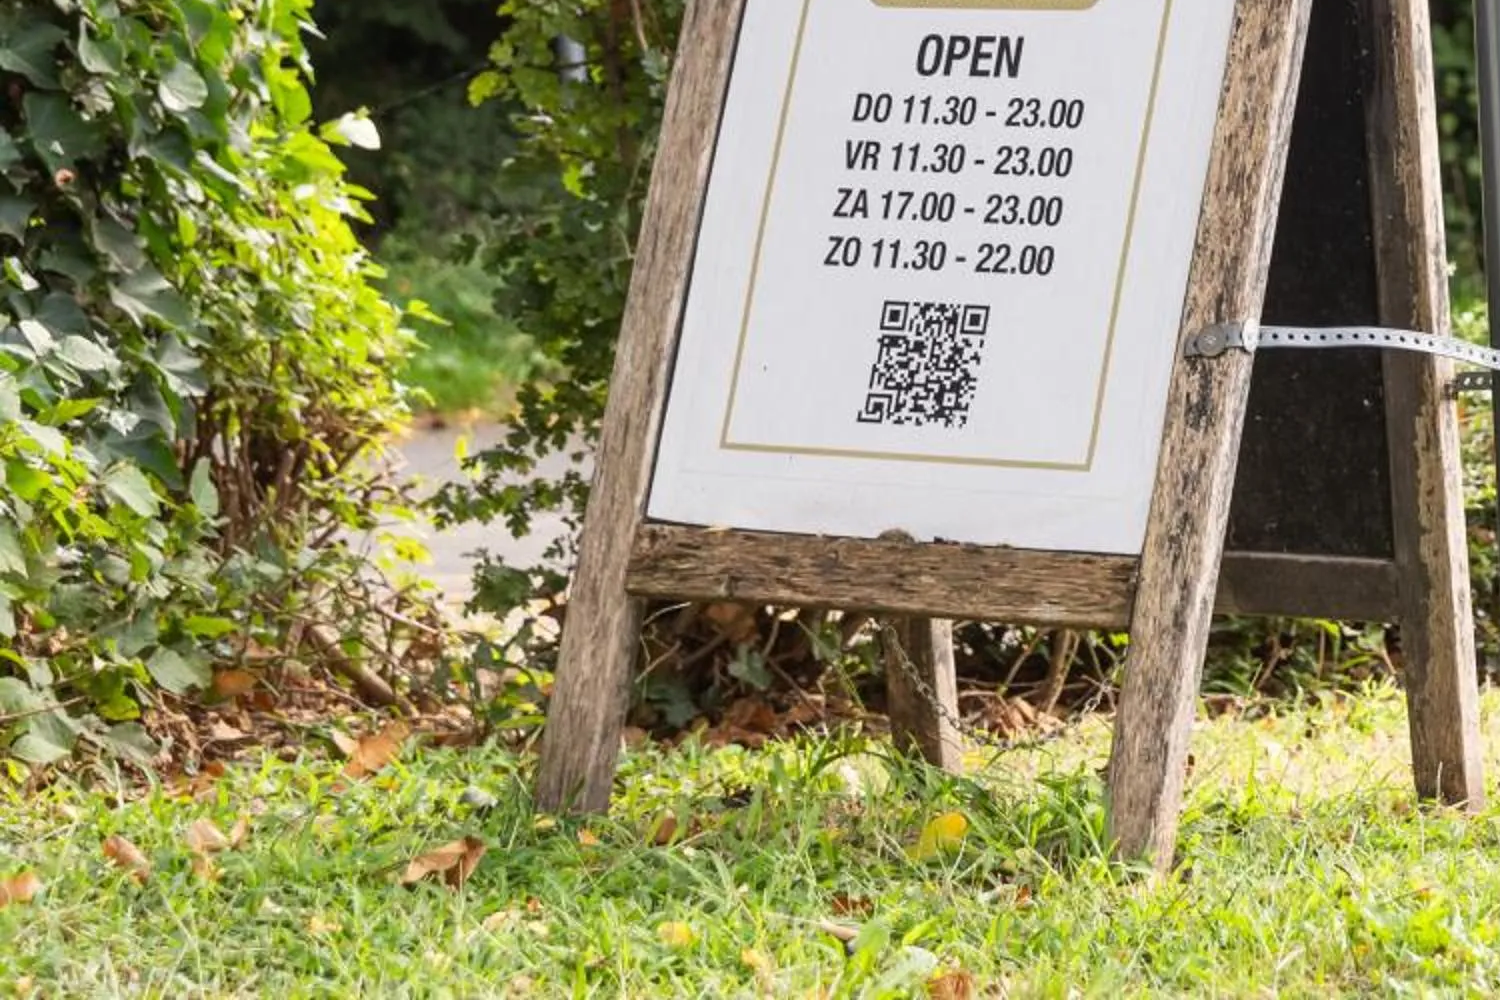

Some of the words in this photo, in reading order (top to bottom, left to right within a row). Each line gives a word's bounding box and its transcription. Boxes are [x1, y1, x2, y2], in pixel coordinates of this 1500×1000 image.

[917, 34, 1024, 78] OPEN
[853, 93, 892, 123] DO
[904, 95, 976, 125] 11.30
[1005, 98, 1084, 128] 23.00
[846, 140, 880, 170] VR
[892, 143, 965, 174] 11.30
[994, 146, 1072, 177] 23.00
[833, 188, 868, 218] ZA
[882, 191, 955, 222] 17.00
[984, 194, 1063, 226] 23.00
[824, 236, 861, 266] ZO
[872, 239, 946, 270] 11.30
[975, 243, 1054, 275] 22.00
